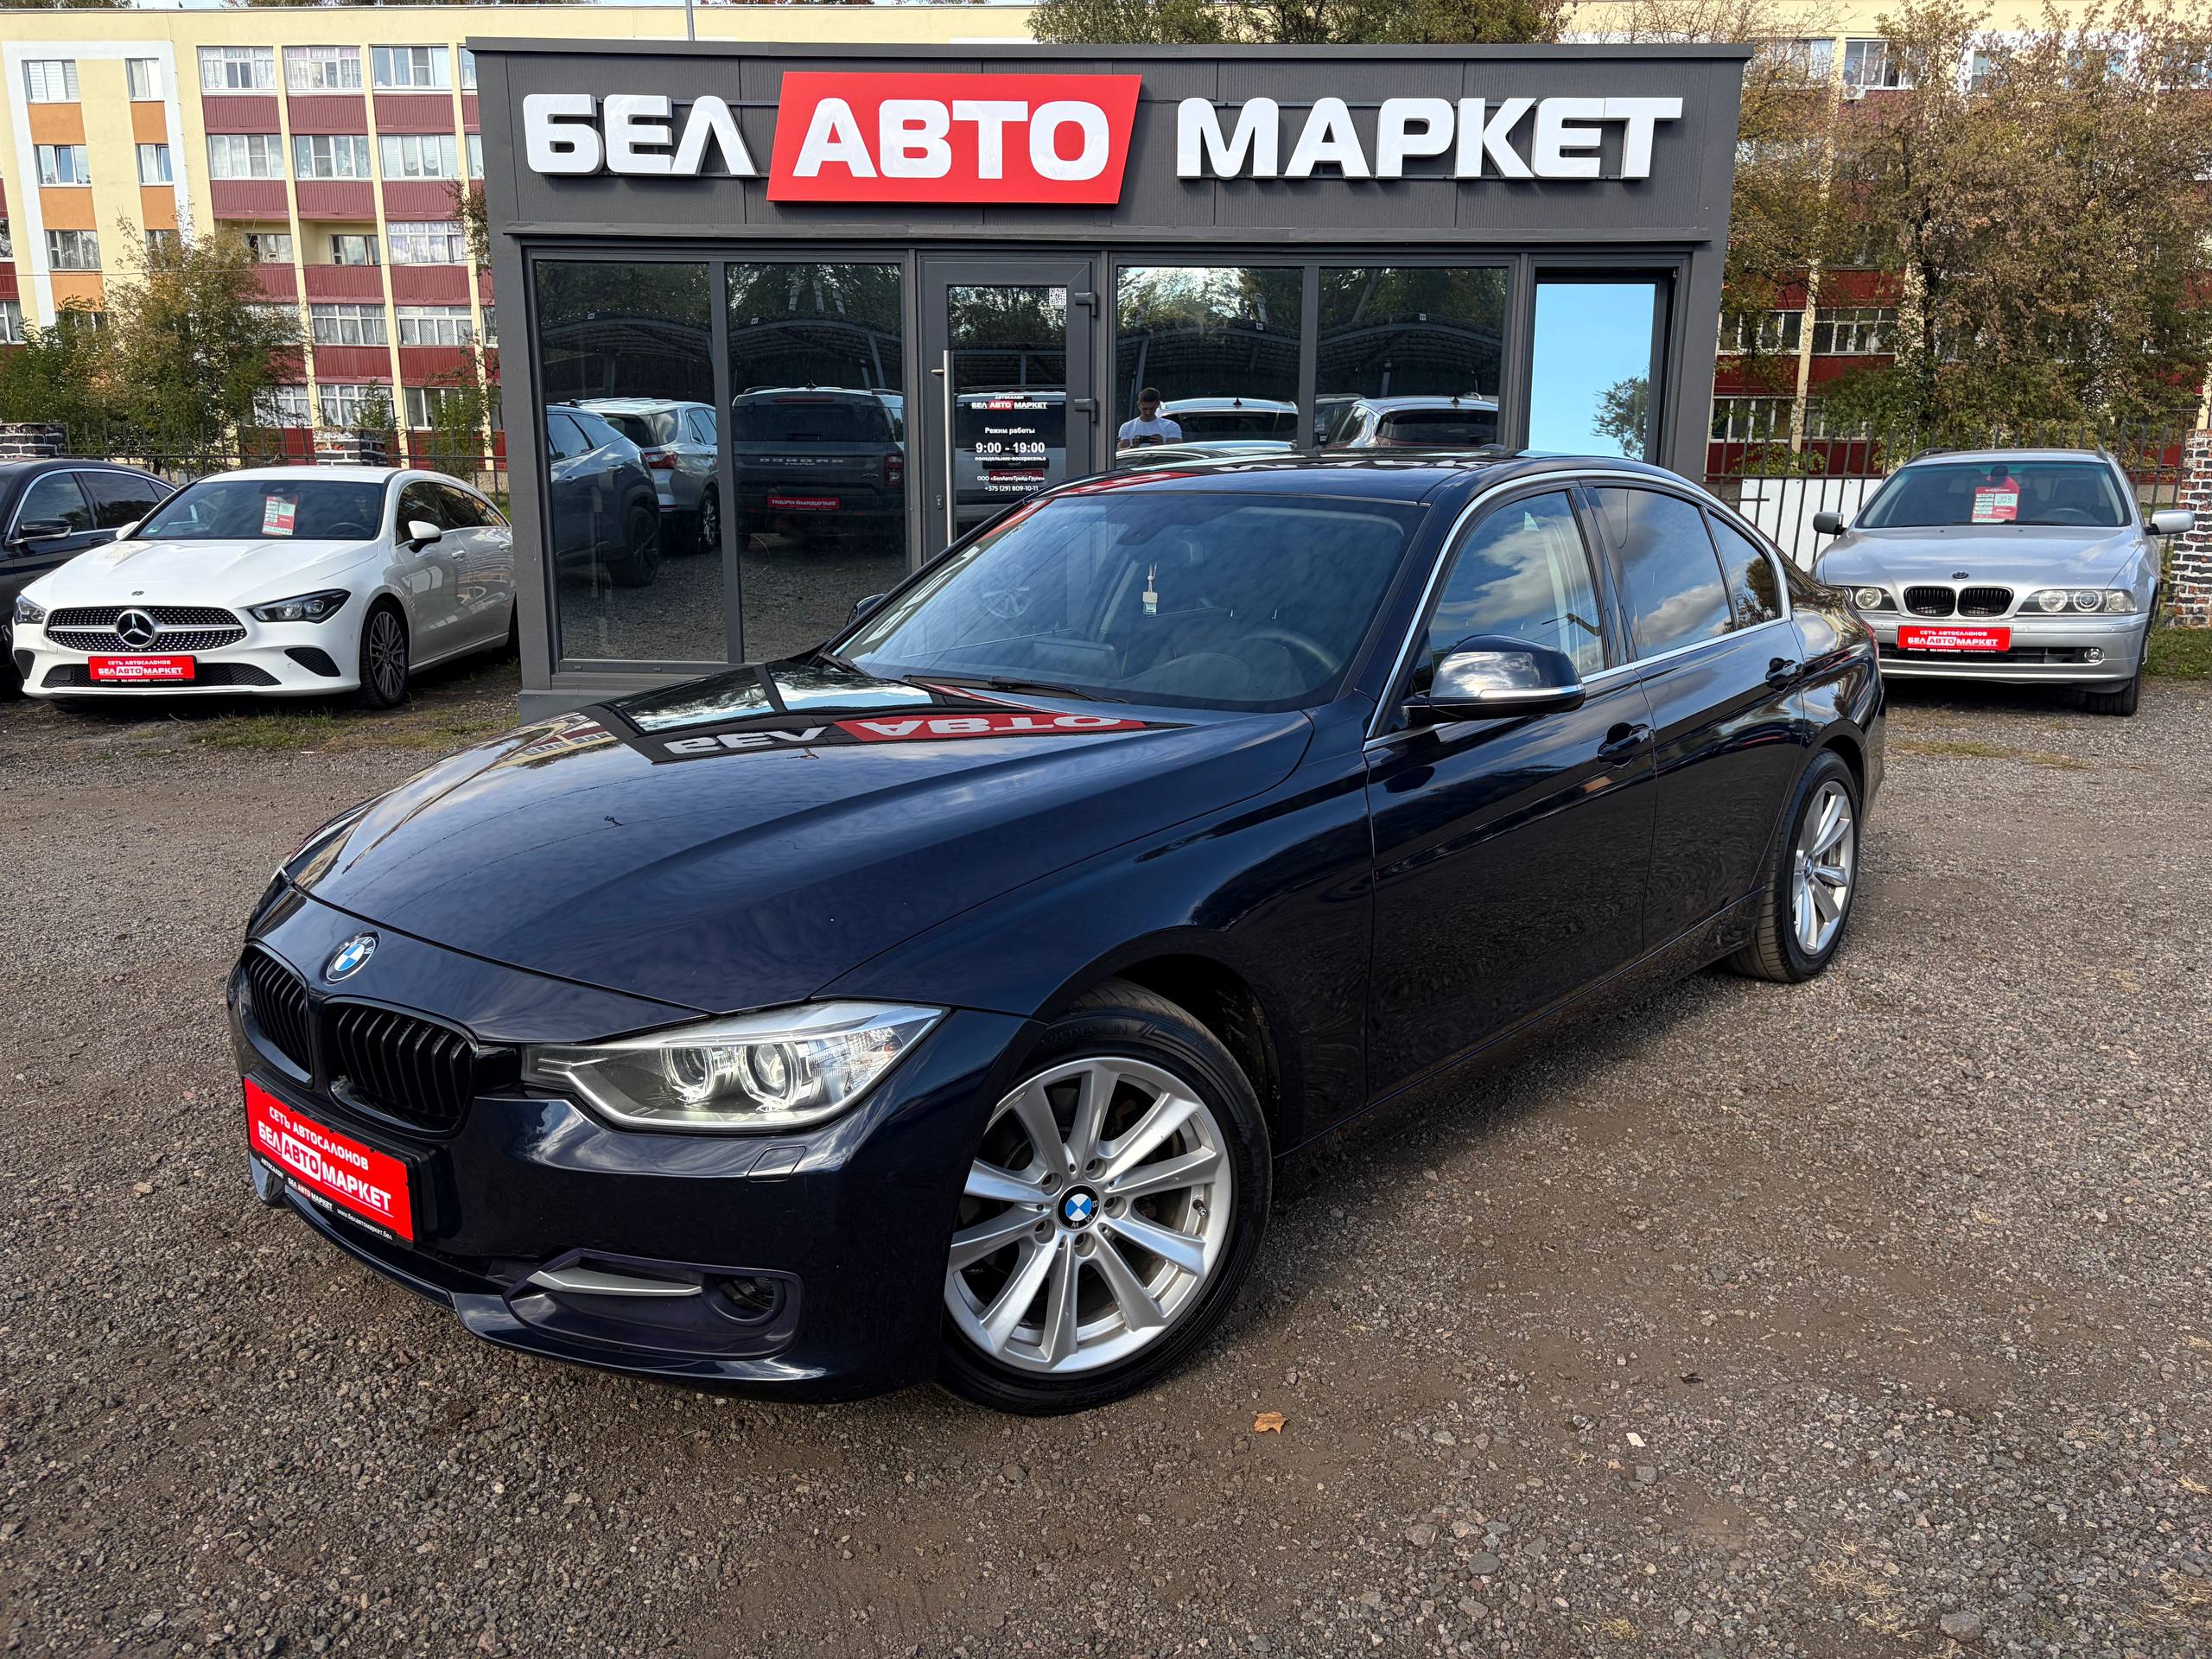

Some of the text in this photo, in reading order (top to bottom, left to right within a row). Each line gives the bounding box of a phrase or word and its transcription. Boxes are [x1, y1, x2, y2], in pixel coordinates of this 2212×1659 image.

[522, 93, 1684, 181] БЕЛ АВТО МАРКЕТ
[976, 442, 1001, 453] 9:00
[1013, 442, 1046, 453] 19:00
[258, 1120, 391, 1211] БЕЛ АВТО МАРКЕТ
[269, 1106, 370, 1171] СЕТЬ АВТОСАЛОНОВ
[311, 1192, 334, 1211] МАРКЕТ
